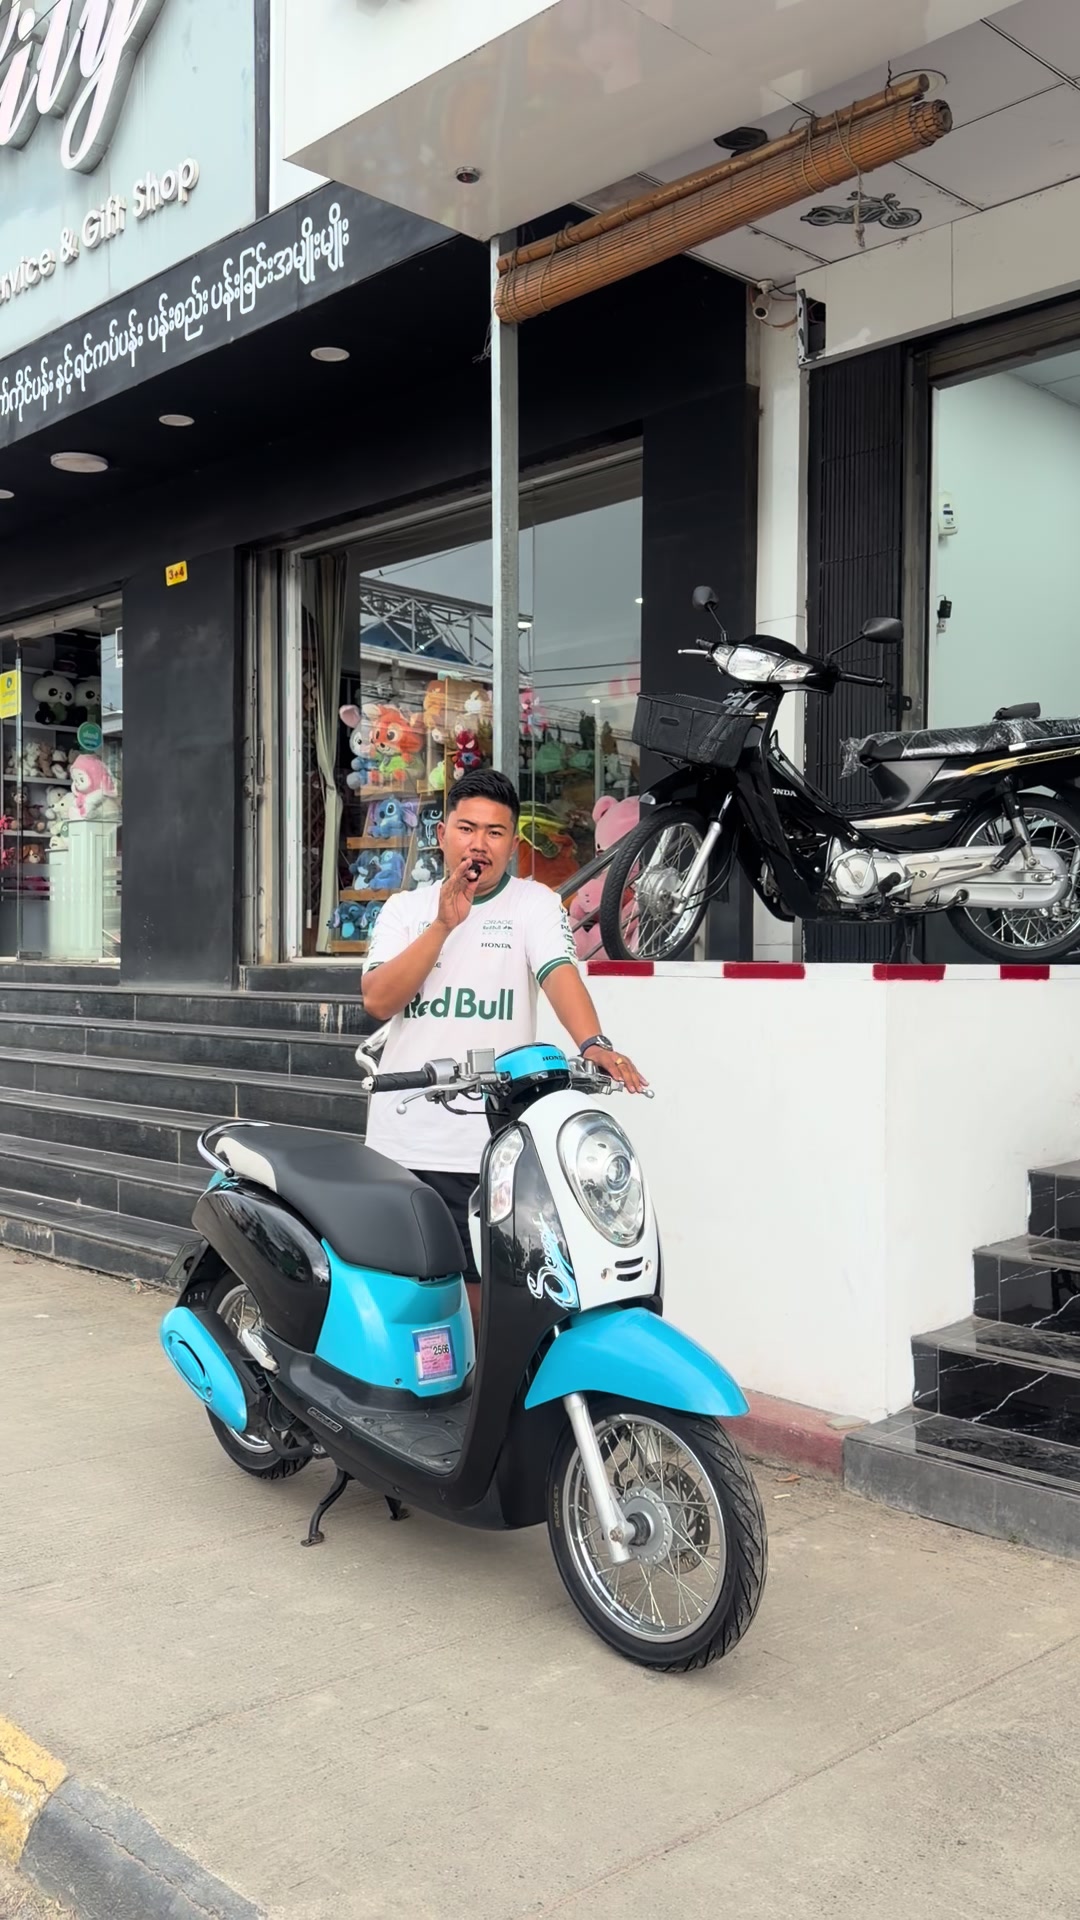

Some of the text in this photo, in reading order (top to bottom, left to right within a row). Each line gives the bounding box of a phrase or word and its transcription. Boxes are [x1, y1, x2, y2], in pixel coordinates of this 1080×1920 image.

[0, 157, 199, 302] rvice & Gift Shop
[403, 986, 515, 1021] Red Bull
